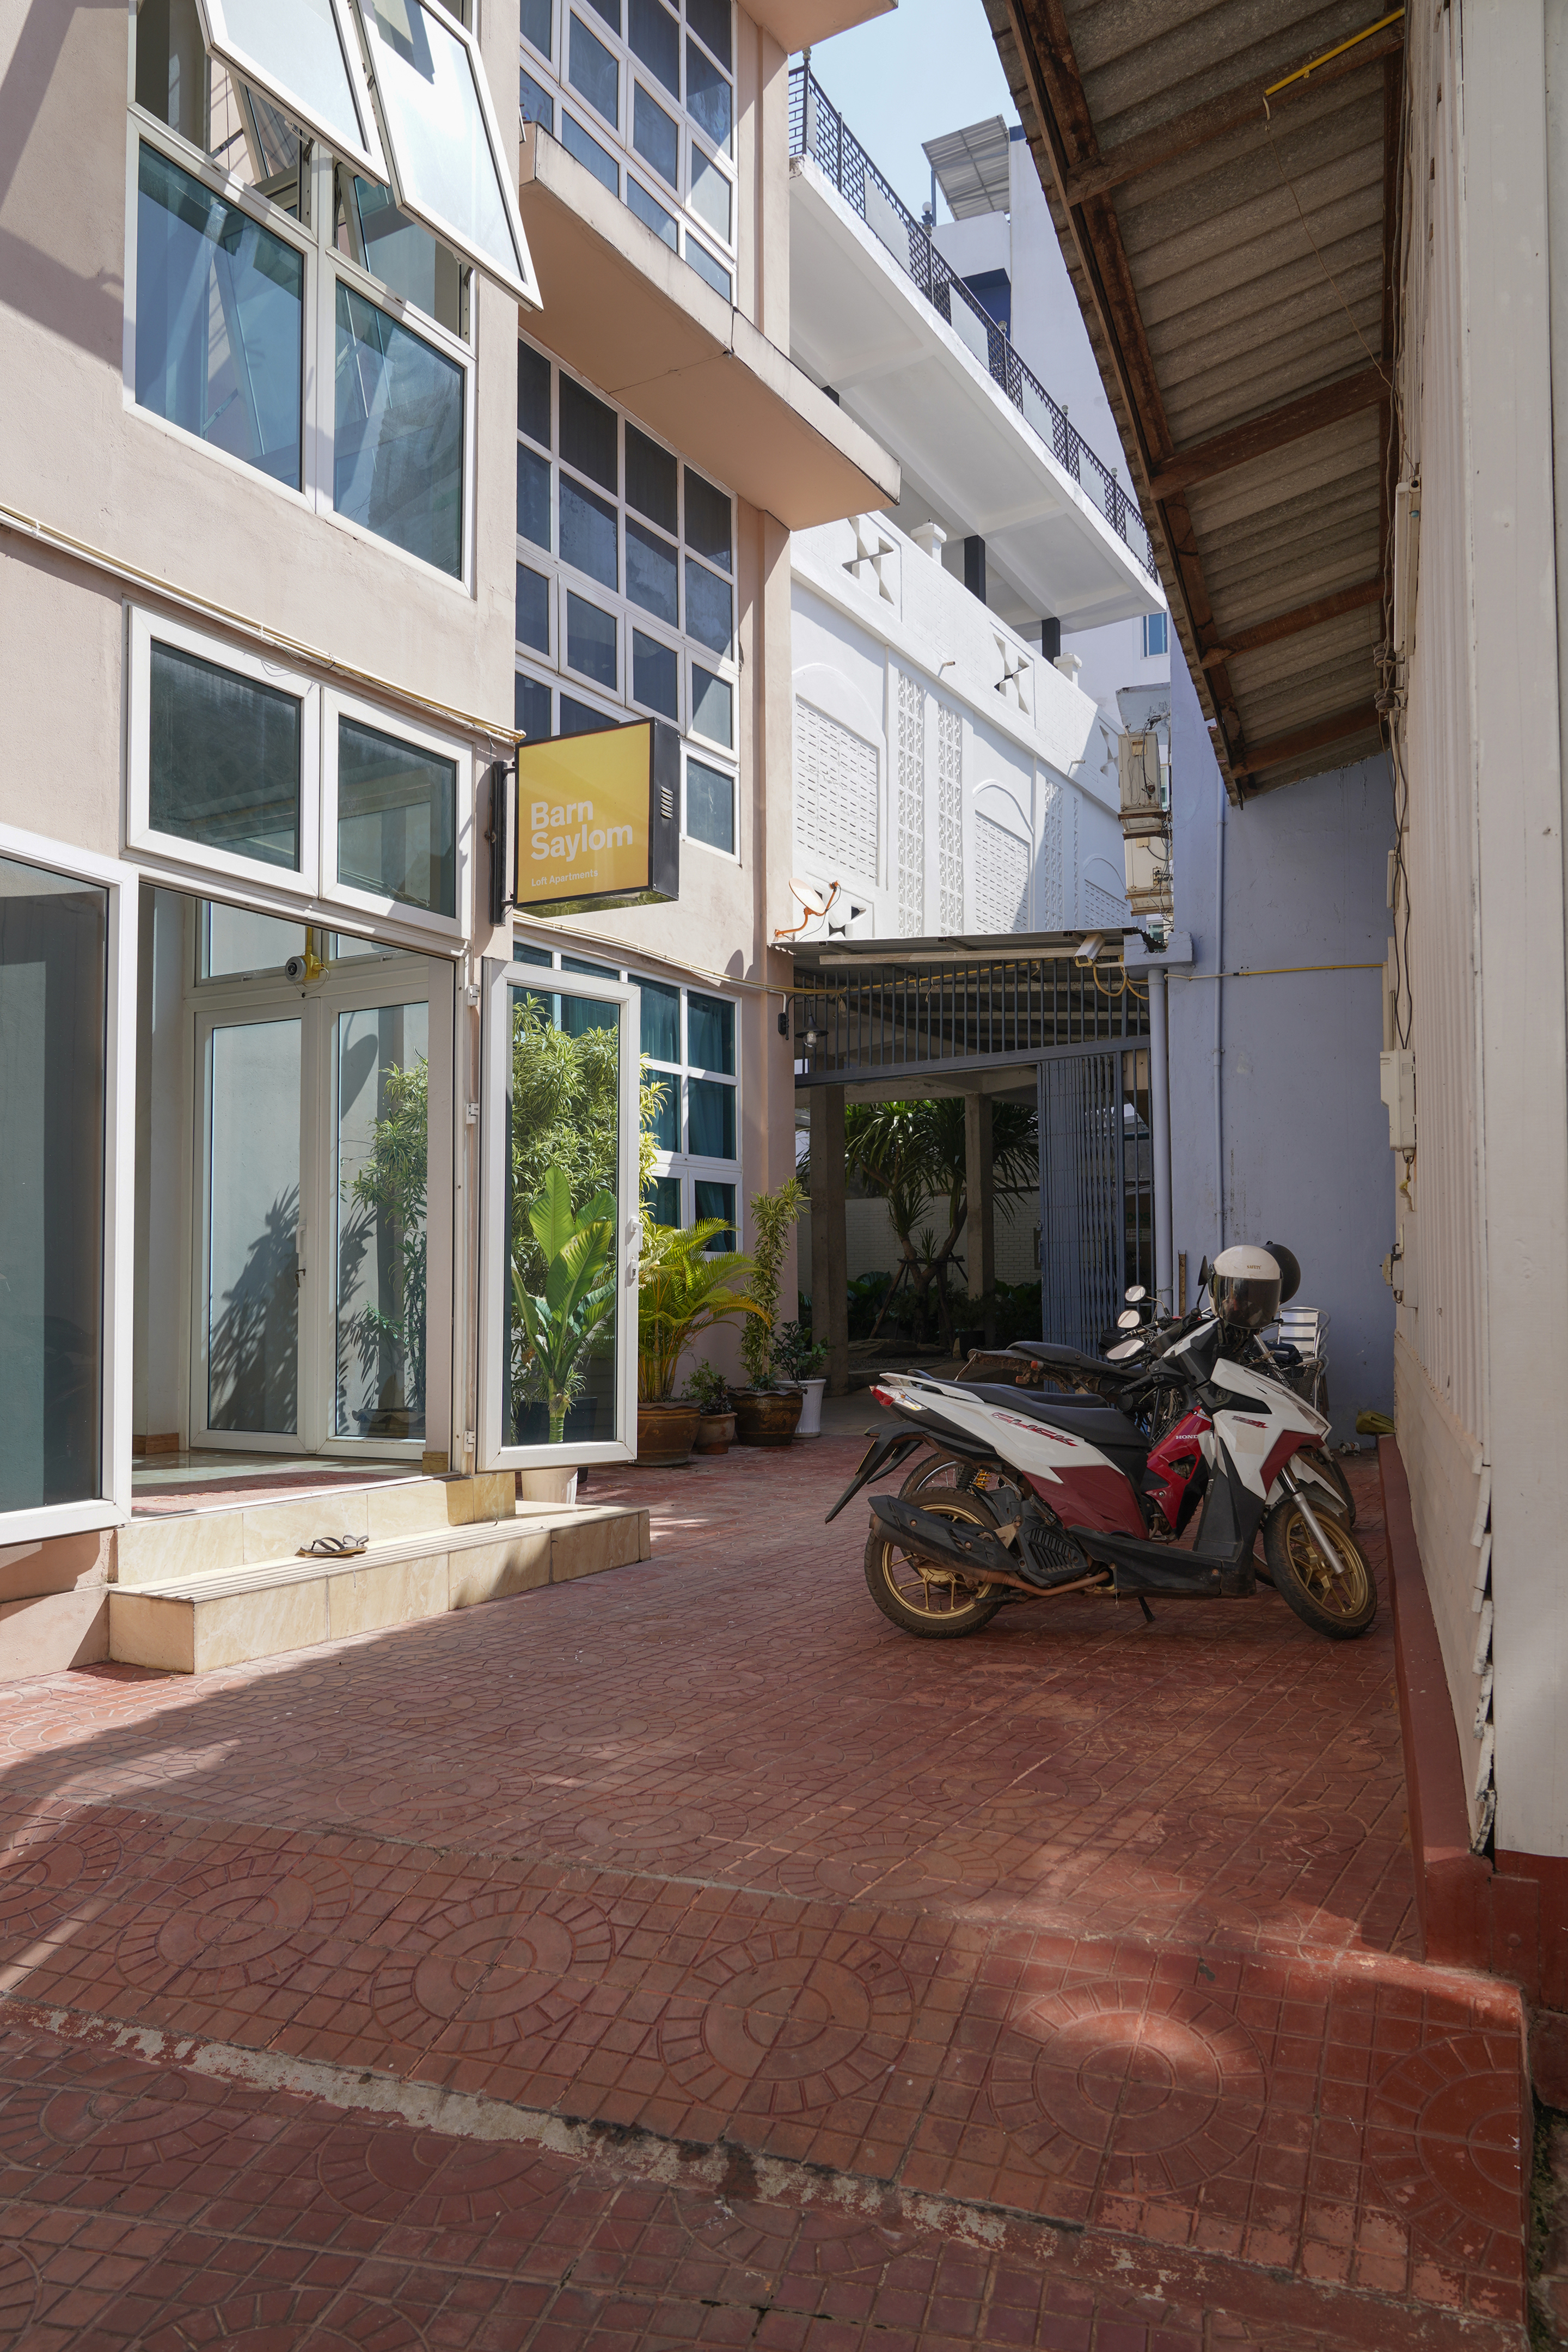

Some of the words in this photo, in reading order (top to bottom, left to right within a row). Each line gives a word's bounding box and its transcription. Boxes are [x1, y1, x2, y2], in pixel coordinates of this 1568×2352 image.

[531, 801, 593, 830] Barn
[530, 824, 633, 862] Saylom
[531, 877, 547, 887] Loft
[549, 869, 598, 885] Apartments
[991, 1412, 1079, 1447] CLICK
